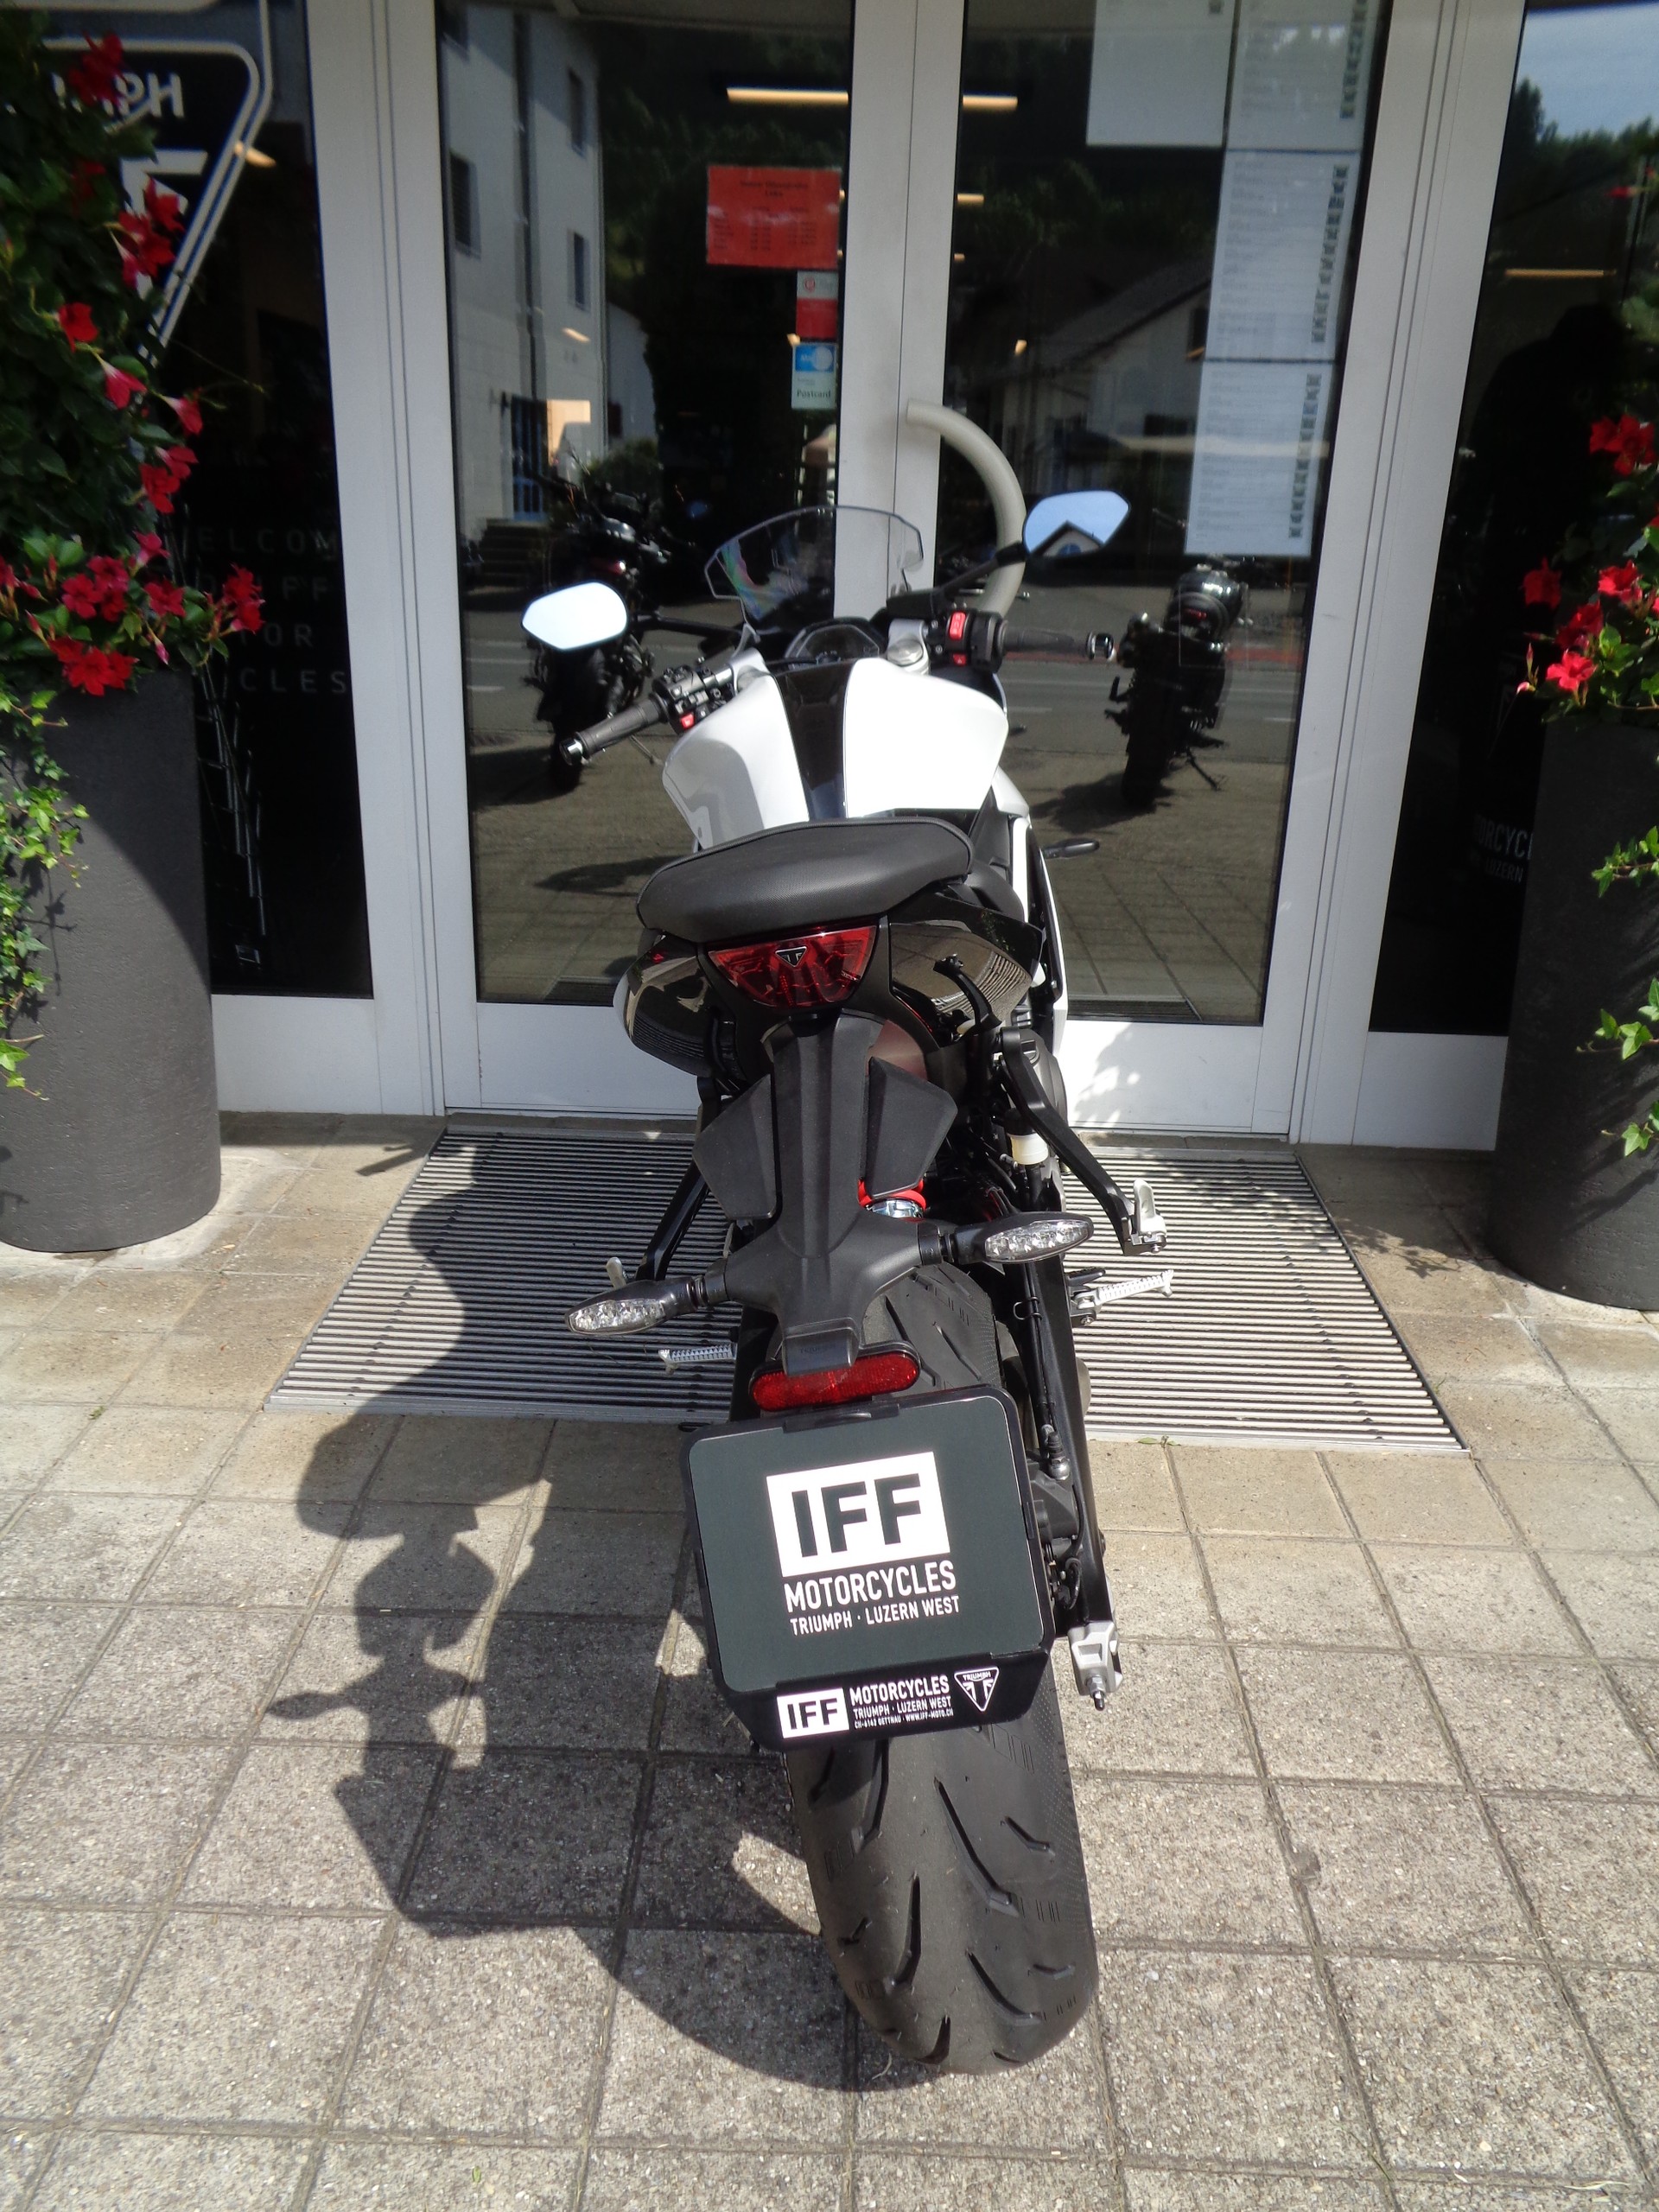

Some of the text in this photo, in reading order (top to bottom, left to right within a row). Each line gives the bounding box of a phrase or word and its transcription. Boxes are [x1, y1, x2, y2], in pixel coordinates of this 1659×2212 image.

[797, 388, 831, 398] Postcard
[791, 1473, 921, 1557] IFF
[784, 1560, 957, 1612] MOTORCYCLES
[790, 1595, 959, 1636] TRIUMPH LUZERN WEST
[849, 1675, 950, 1707] MOTORCYCLES
[963, 1671, 991, 1681] TRIUMPH
[787, 1698, 838, 1731] IFF
[853, 1695, 951, 1719] TRIUMPH LUZERN WEST
[878, 1715, 902, 1726] GETTNAU
[905, 1708, 954, 1722] WWW.IFF-MOTO.CH
